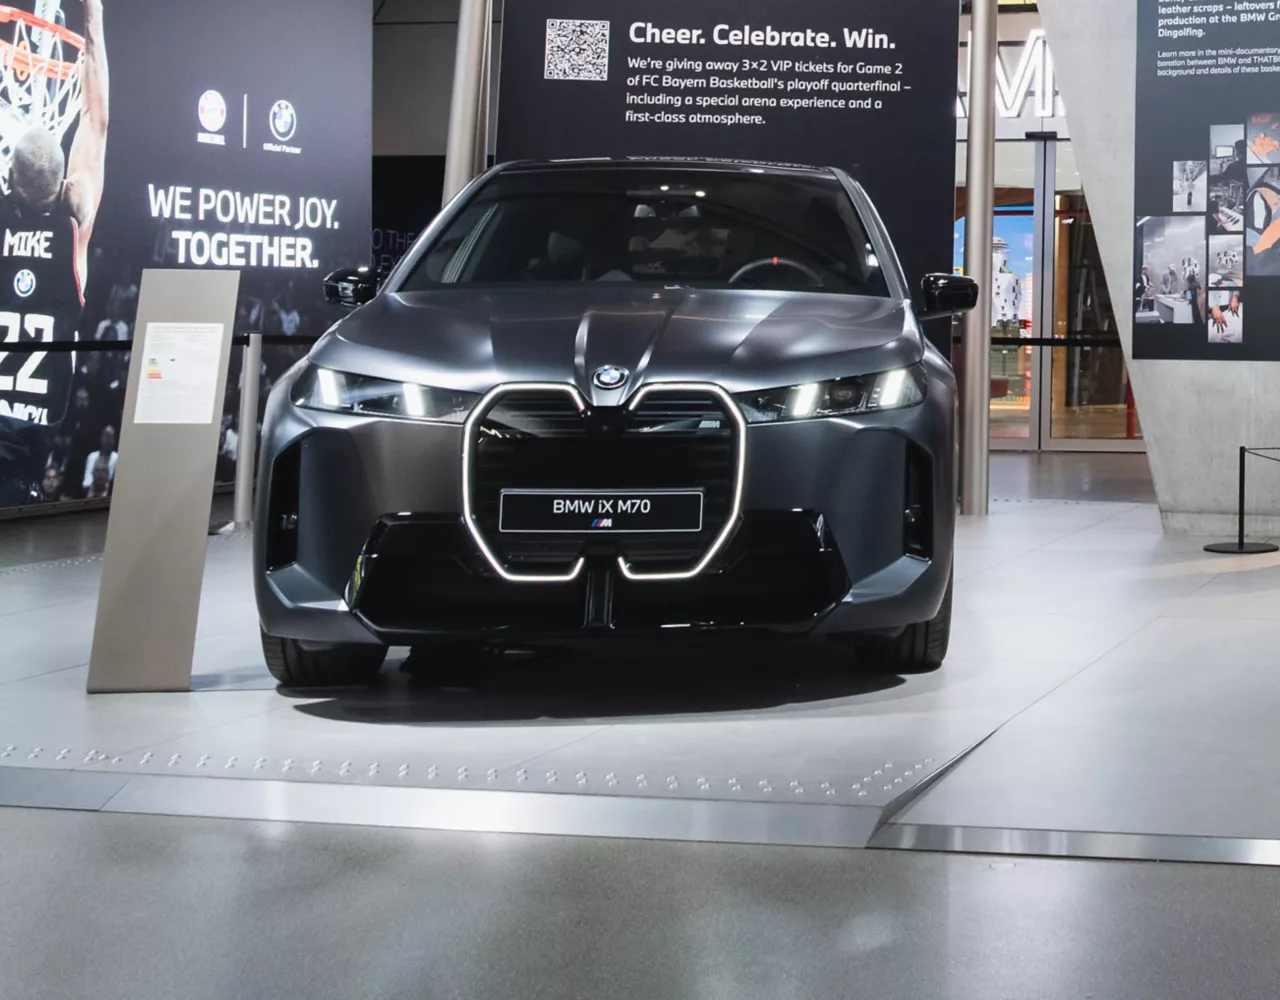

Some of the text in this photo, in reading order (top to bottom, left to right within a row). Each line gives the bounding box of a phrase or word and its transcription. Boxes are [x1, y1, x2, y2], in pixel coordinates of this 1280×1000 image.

[1158, 5, 1191, 14] leather
[1193, 4, 1224, 13] scraps
[1234, 1, 1275, 10] leftovers
[1158, 16, 1207, 27] production
[1209, 15, 1219, 23] at
[1222, 14, 1237, 22] the
[1240, 13, 1266, 22] BMW
[629, 22, 896, 49] Cheer. Celebrate. Win.
[1158, 28, 1206, 38] Dingolfing.
[1157, 50, 1177, 58] Learn
[1218, 47, 1280, 55] mini-documentary
[628, 57, 662, 69] We're
[666, 58, 702, 72] giving
[706, 61, 739, 72] away
[770, 60, 792, 71] VIP
[795, 61, 834, 72] tickets
[837, 62, 854, 73] for
[856, 62, 892, 74] Game
[895, 63, 903, 74] 2
[1186, 58, 1216, 66] between
[1218, 57, 1237, 65] BMW
[1238, 56, 1251, 64] and
[1157, 68, 1195, 77] background
[1210, 66, 1232, 74] details
[1241, 65, 1259, 73] these
[627, 75, 640, 86] of
[642, 75, 659, 86] FC
[662, 75, 706, 89] Bayern
[710, 77, 784, 89] Basketball's
[787, 79, 829, 92] playoff
[831, 80, 900, 92] quarterfinal
[626, 93, 882, 109] including a special arena experience and a
[625, 111, 766, 126] first-class atmosphere.
[148, 184, 339, 230] WE POWER JOY.
[3, 228, 53, 258] MIKE
[172, 230, 319, 268] TOGETHER.
[553, 499, 651, 513] BMW iX M70
